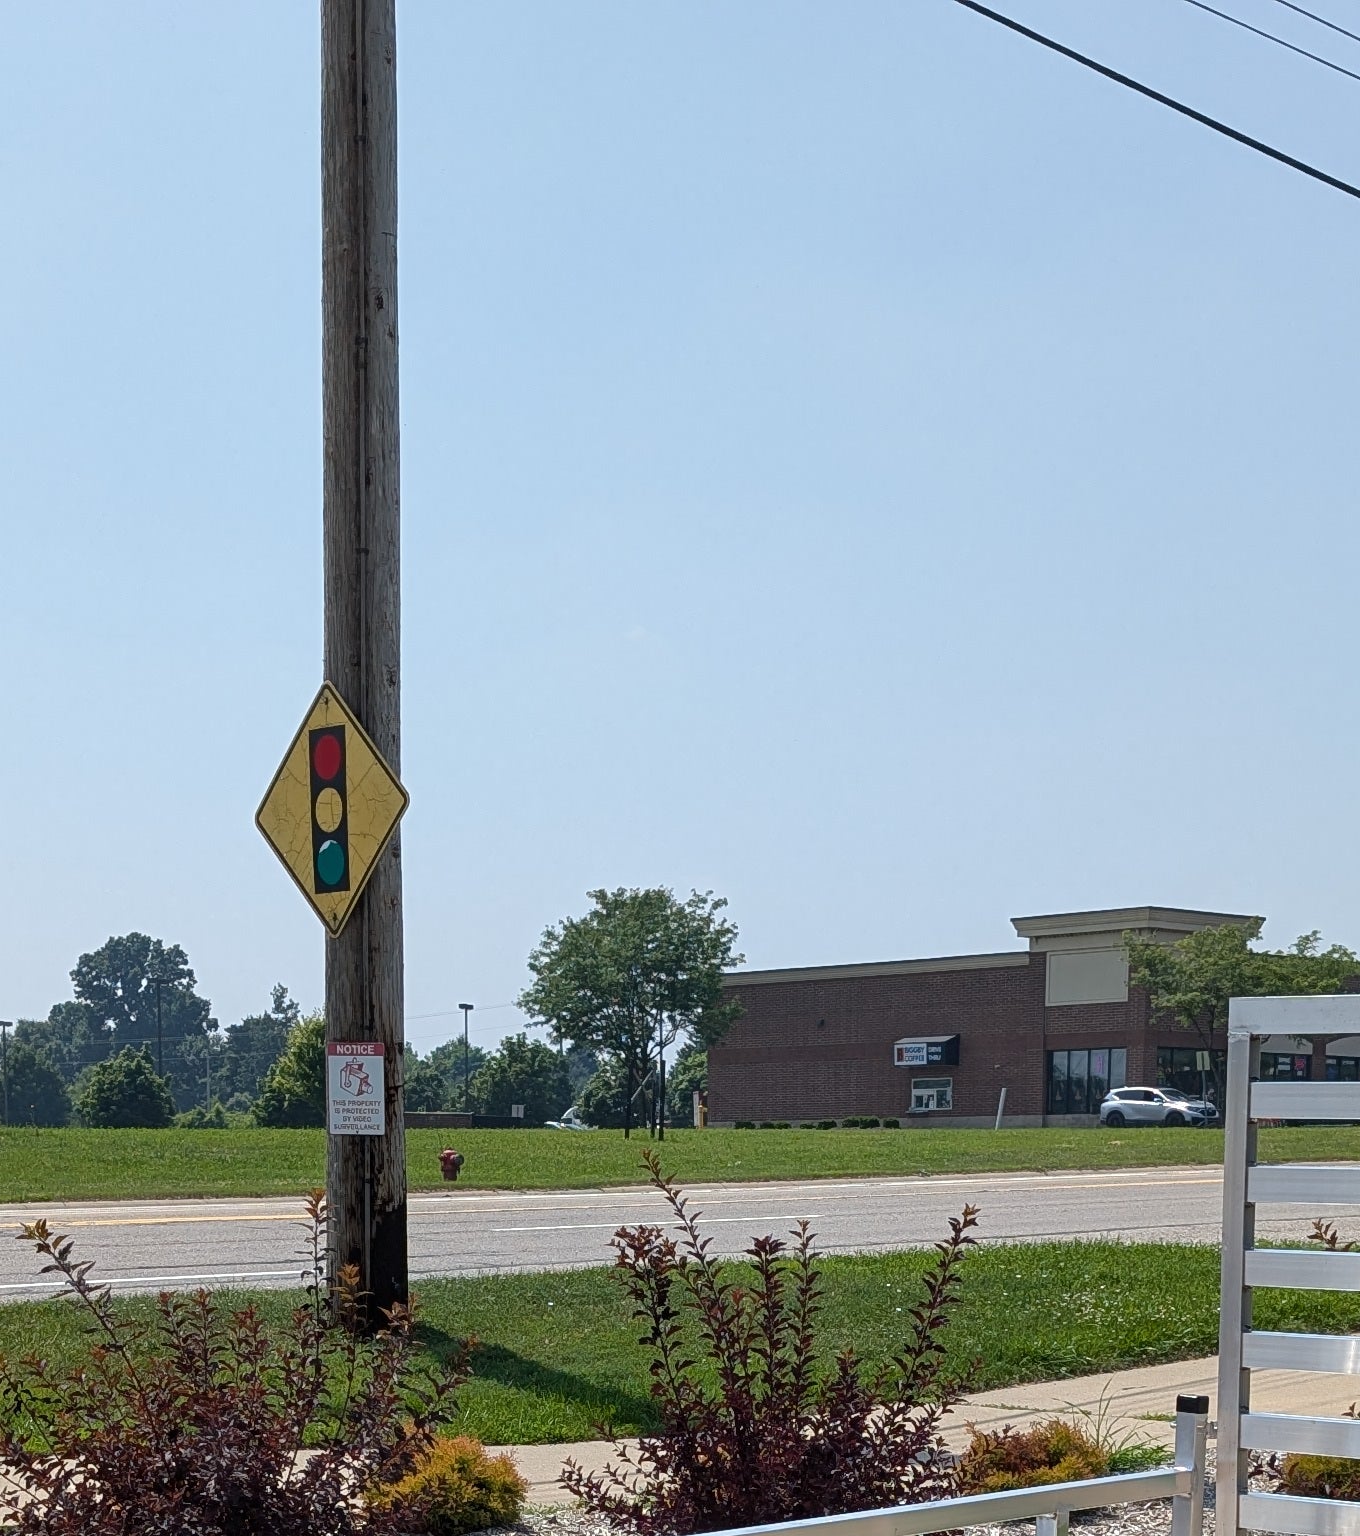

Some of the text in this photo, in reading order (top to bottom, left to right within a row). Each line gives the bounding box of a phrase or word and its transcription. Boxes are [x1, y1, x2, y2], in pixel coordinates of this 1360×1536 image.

[336, 1044, 375, 1055] NOTICE
[332, 1099, 382, 1107] THIS PROPERTY
[333, 1123, 381, 1131] SURVEILLANCE
